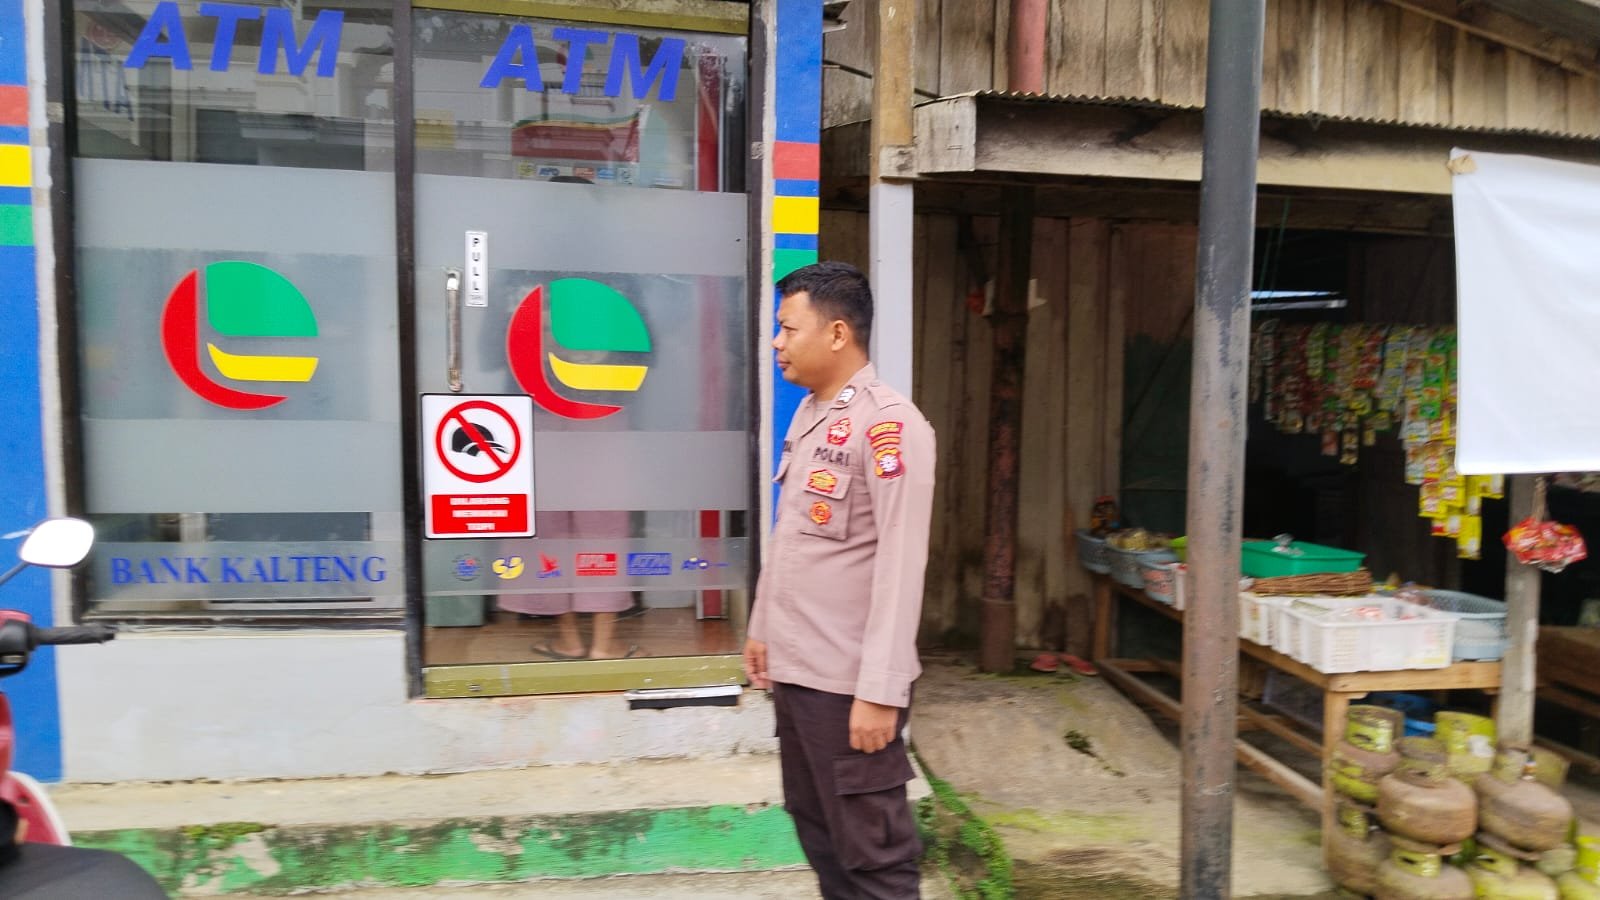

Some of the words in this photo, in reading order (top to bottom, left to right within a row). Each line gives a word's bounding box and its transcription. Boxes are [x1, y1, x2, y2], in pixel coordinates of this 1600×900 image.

[123, 0, 345, 78] ATM
[480, 24, 687, 102] ATM
[471, 237, 481, 291] PULL
[813, 446, 850, 466] POLRI
[110, 556, 210, 584] BANK
[220, 554, 387, 584] KALTENG
